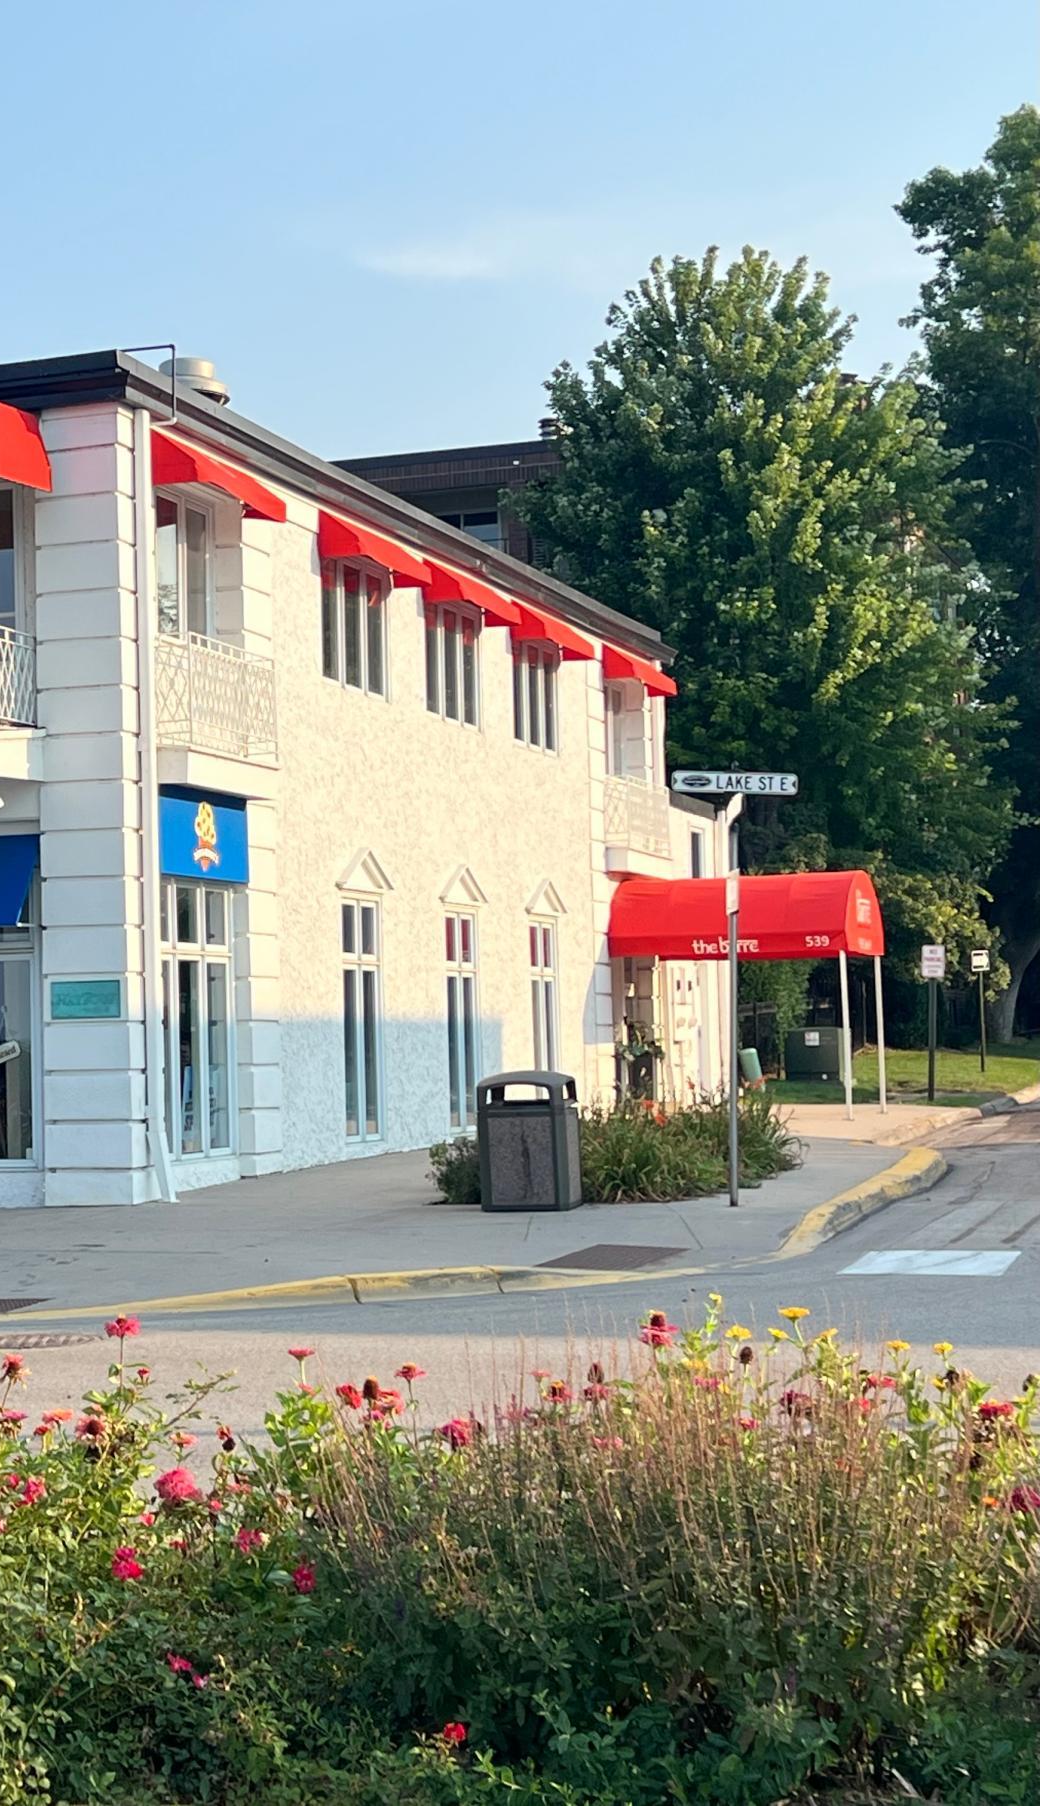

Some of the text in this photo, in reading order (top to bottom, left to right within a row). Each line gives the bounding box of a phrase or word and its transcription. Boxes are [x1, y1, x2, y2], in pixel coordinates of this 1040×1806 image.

[716, 775, 752, 790] LAKE
[758, 776, 774, 790] ST
[780, 777, 789, 791] E
[692, 936, 759, 954] the brre
[805, 935, 830, 948] 539
